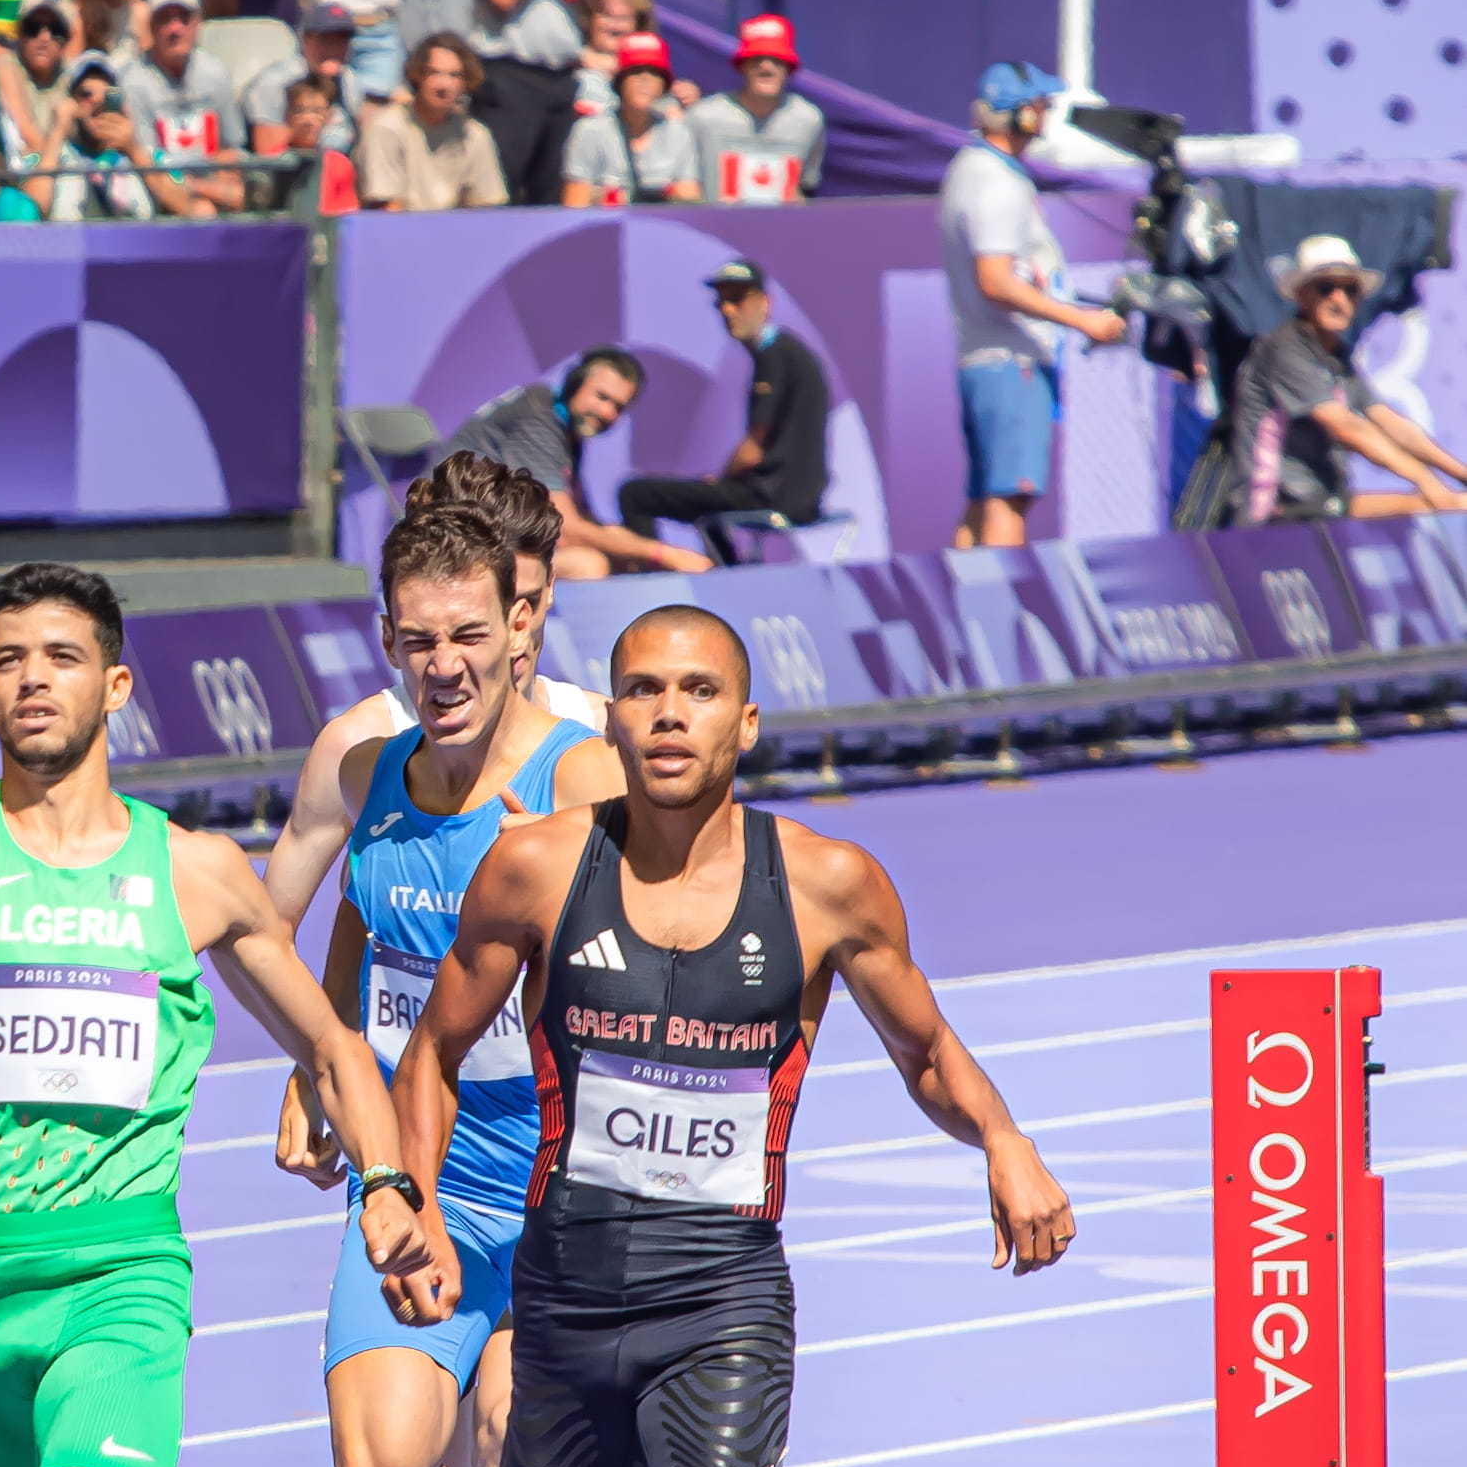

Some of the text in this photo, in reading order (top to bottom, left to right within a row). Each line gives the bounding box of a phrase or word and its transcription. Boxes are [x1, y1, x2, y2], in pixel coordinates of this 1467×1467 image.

[14, 968, 111, 986] PARIS 2024
[565, 1005, 778, 1052] GREAT BRITAIN
[632, 1064, 727, 1089] PARIS 2024
[605, 1107, 736, 1158] GILES
[1248, 1132, 1314, 1419] OMEGA
